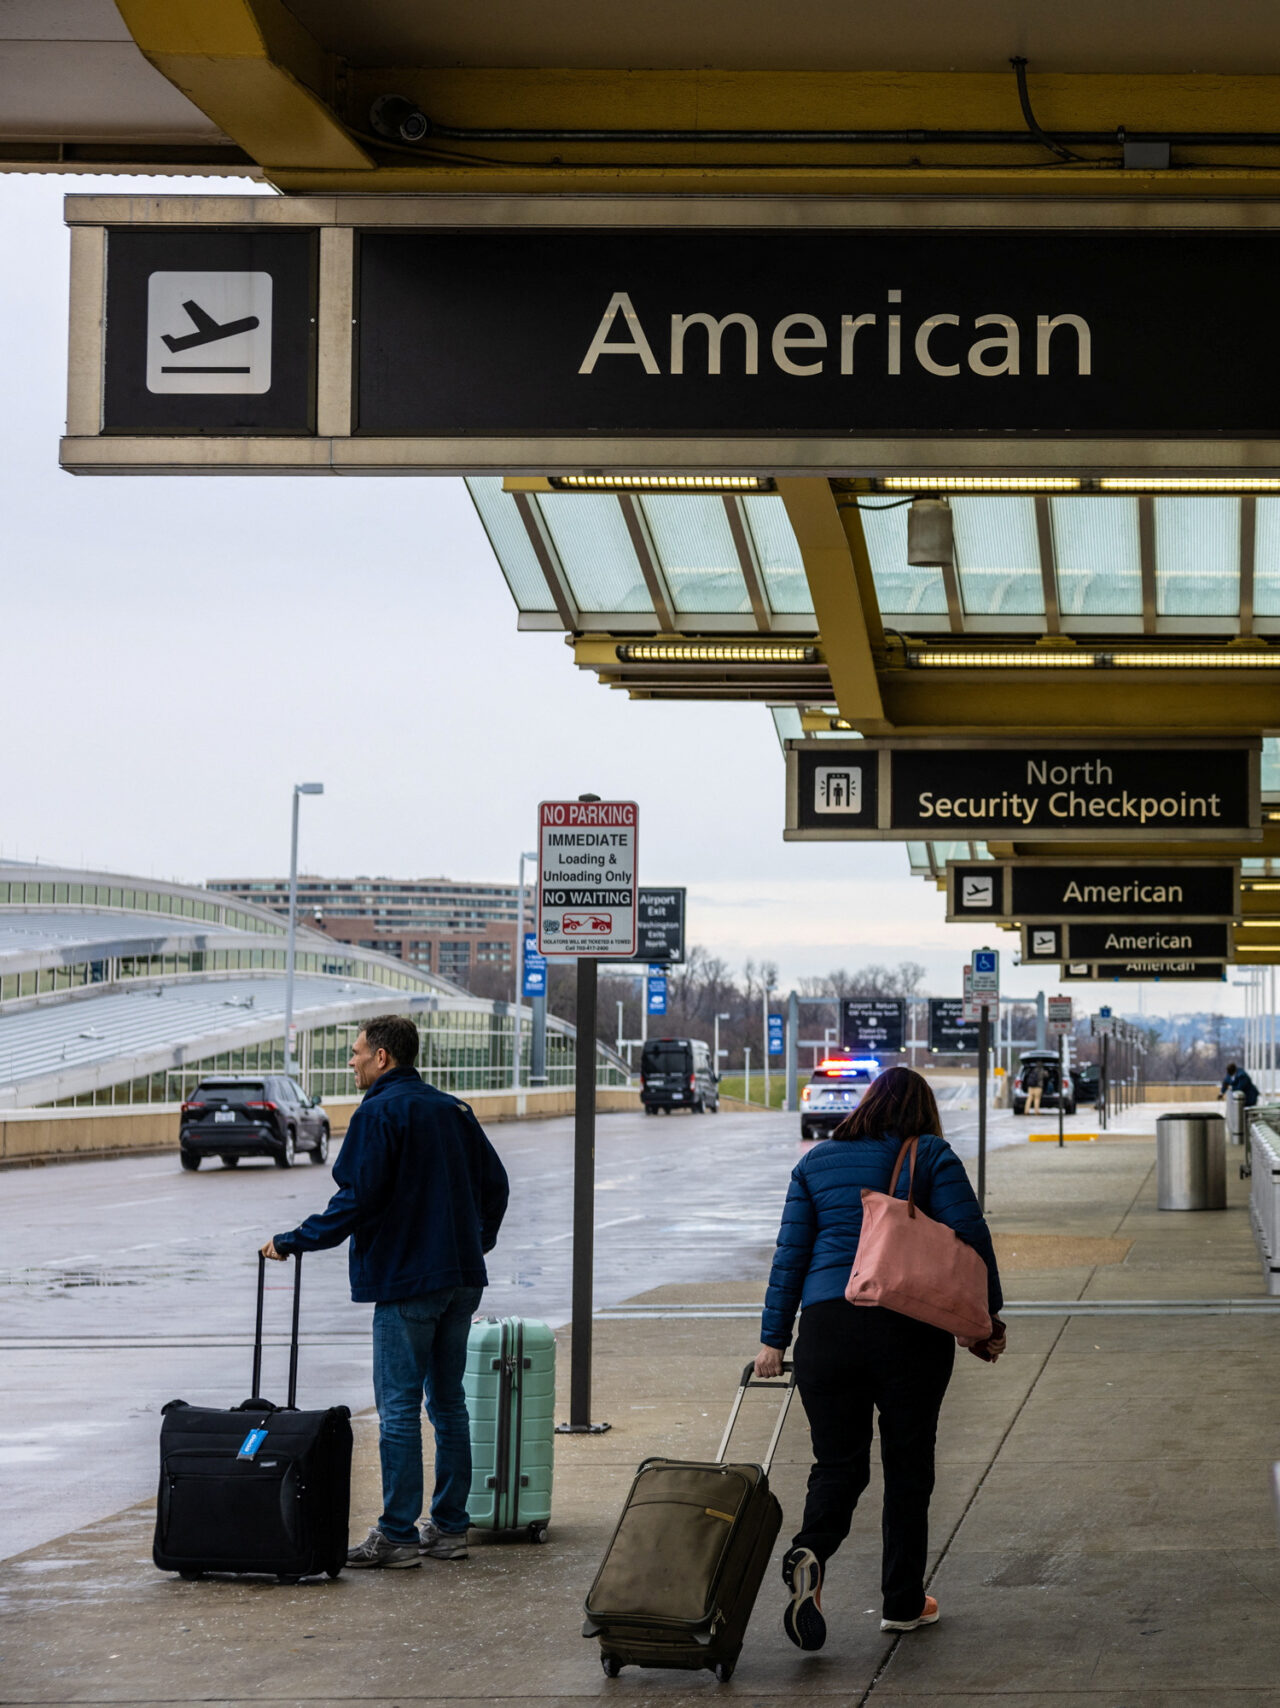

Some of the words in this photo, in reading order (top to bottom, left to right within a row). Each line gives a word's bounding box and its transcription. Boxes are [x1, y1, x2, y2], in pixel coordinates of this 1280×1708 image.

[577, 289, 1092, 377] American
[1027, 759, 1113, 785] North
[543, 805, 565, 824] NO
[569, 805, 634, 824] PARKING
[919, 791, 1038, 824] Security
[1048, 791, 1221, 824] Checkpoint
[548, 833, 628, 846] IMMEDIATE
[558, 853, 605, 867] Loading
[608, 853, 617, 865] &
[543, 870, 602, 885] Unloading
[605, 870, 632, 885] Only
[544, 891, 566, 904] NO
[569, 891, 631, 904] WAITING
[1062, 880, 1184, 904] American
[639, 894, 676, 906] Airport
[647, 906, 667, 916] Exit
[1105, 932, 1193, 949] American
[1126, 962, 1195, 972] American
